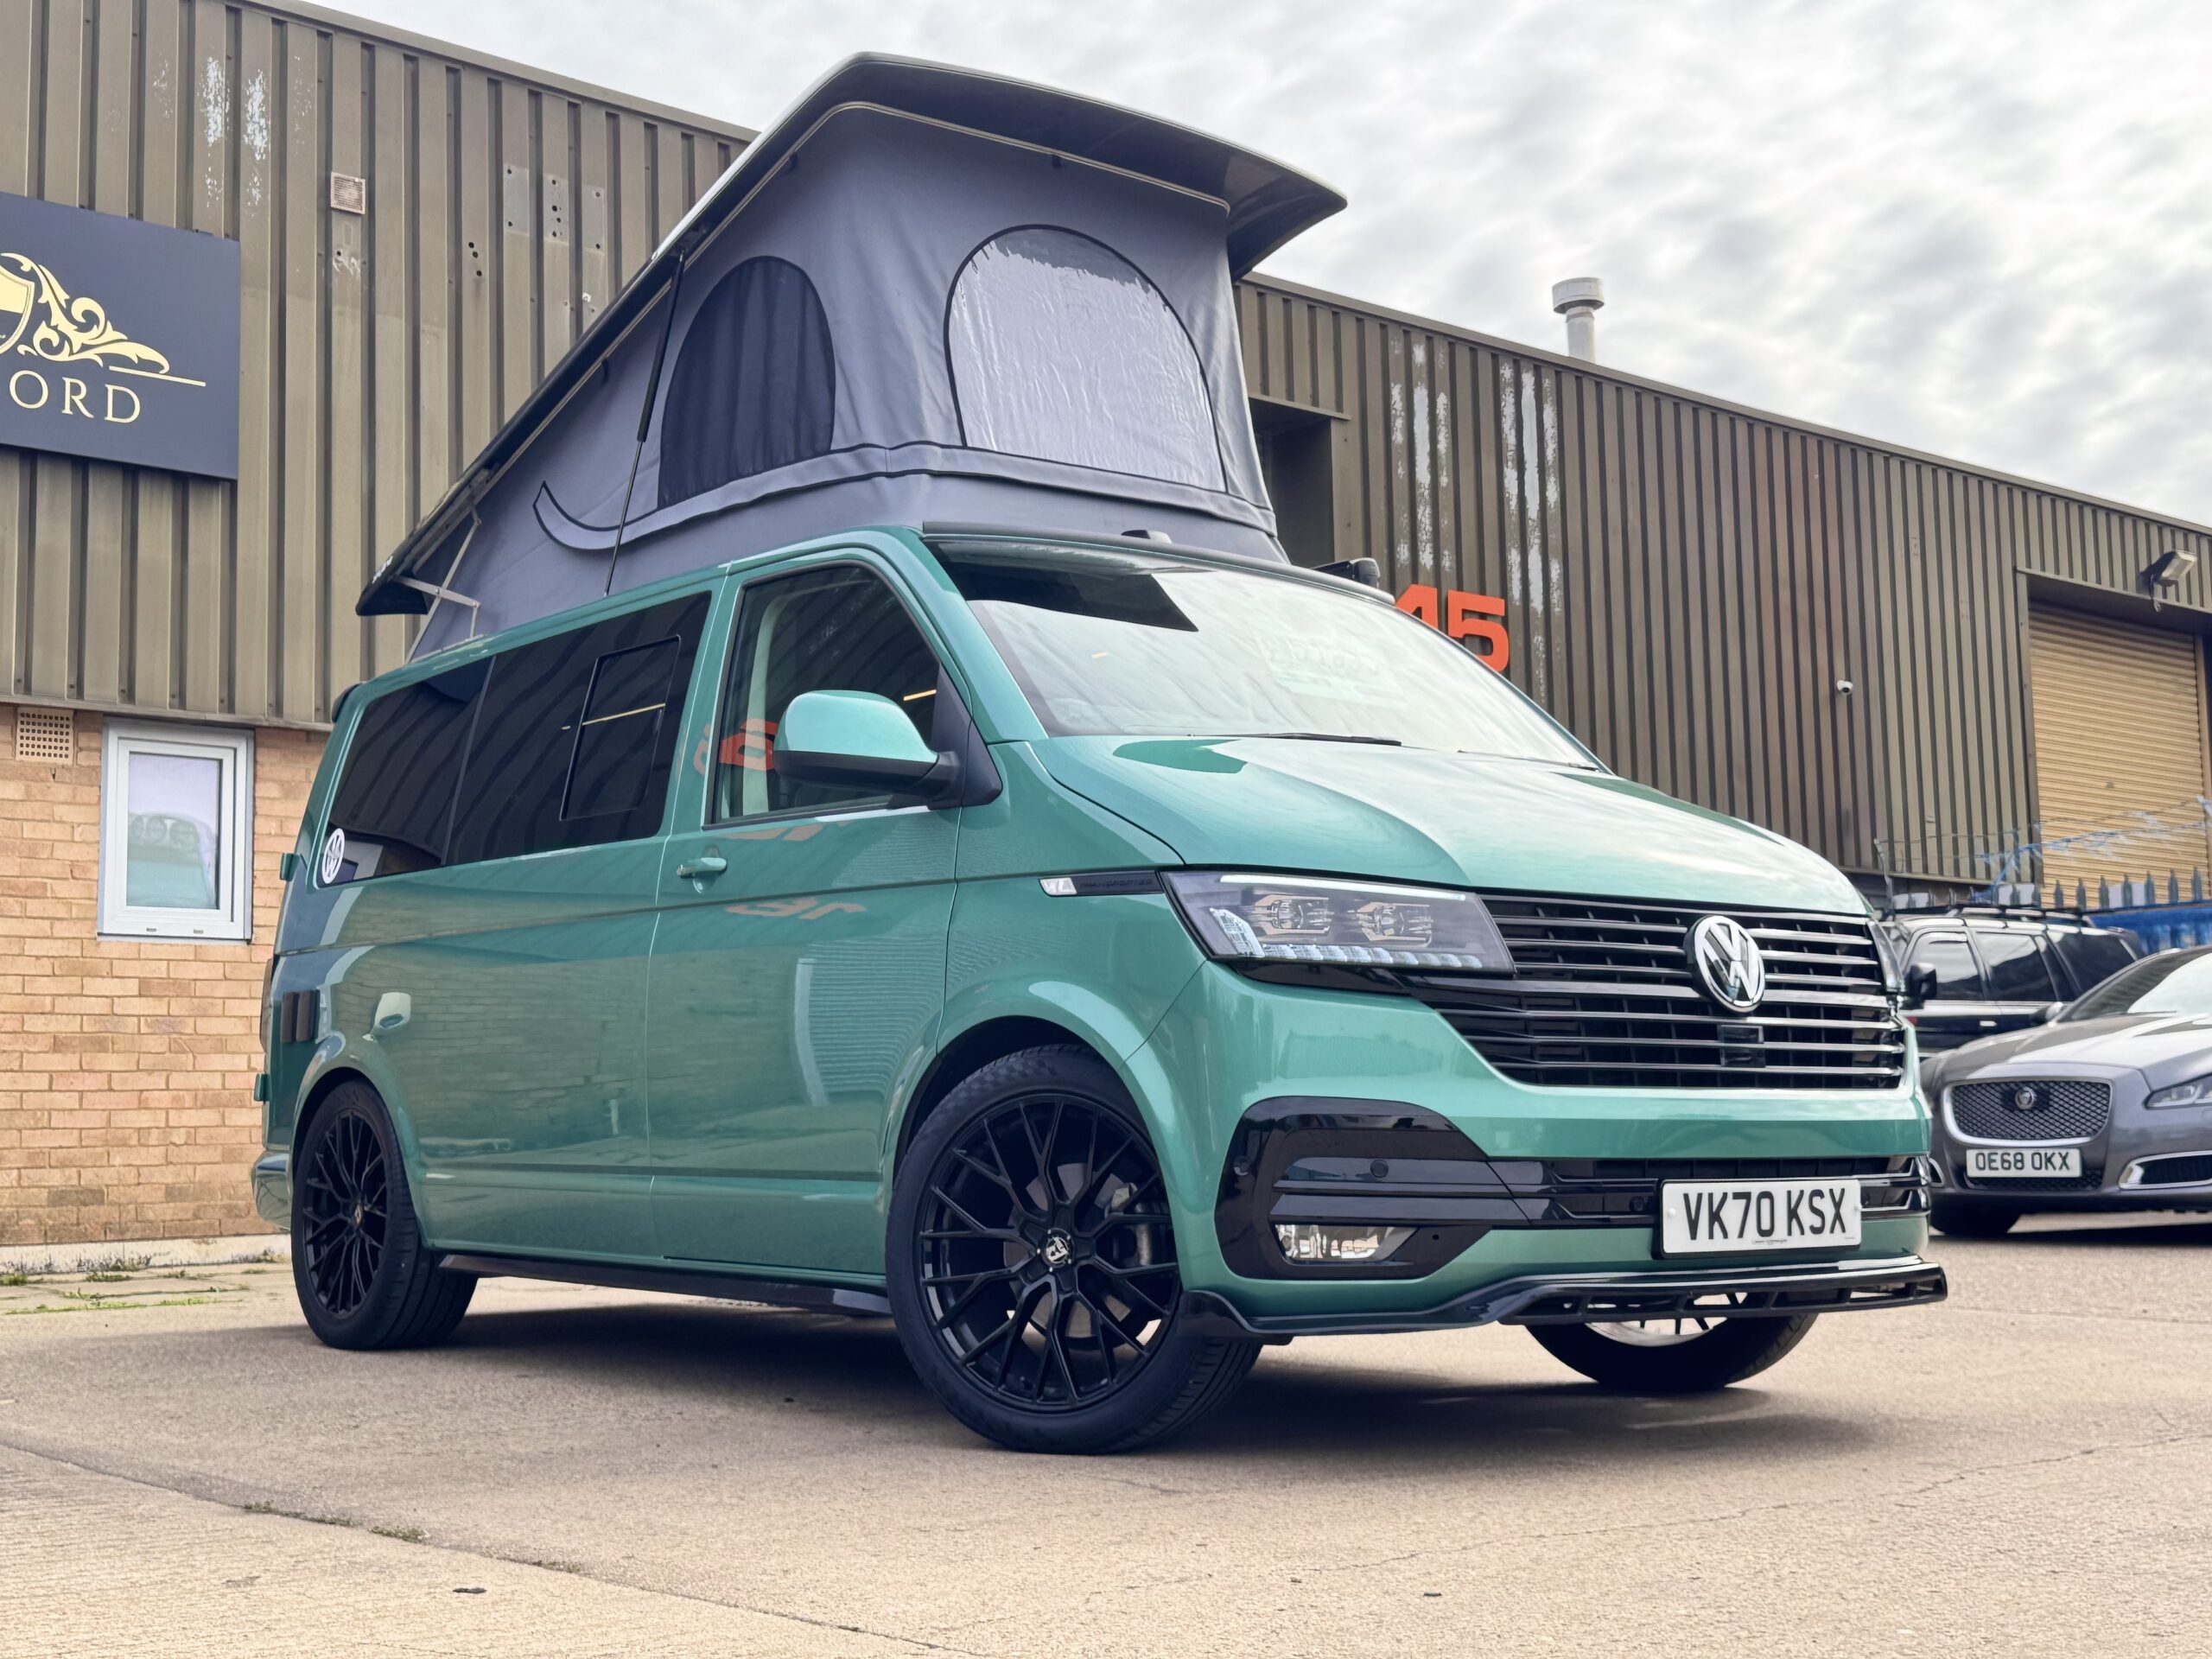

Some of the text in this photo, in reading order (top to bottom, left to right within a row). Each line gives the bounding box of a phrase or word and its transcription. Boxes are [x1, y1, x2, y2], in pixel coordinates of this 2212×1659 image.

[1395, 583, 1510, 672] 45
[1975, 1152, 2069, 1171] OE68 OKX
[1683, 1187, 1847, 1241] VK70 KSX
